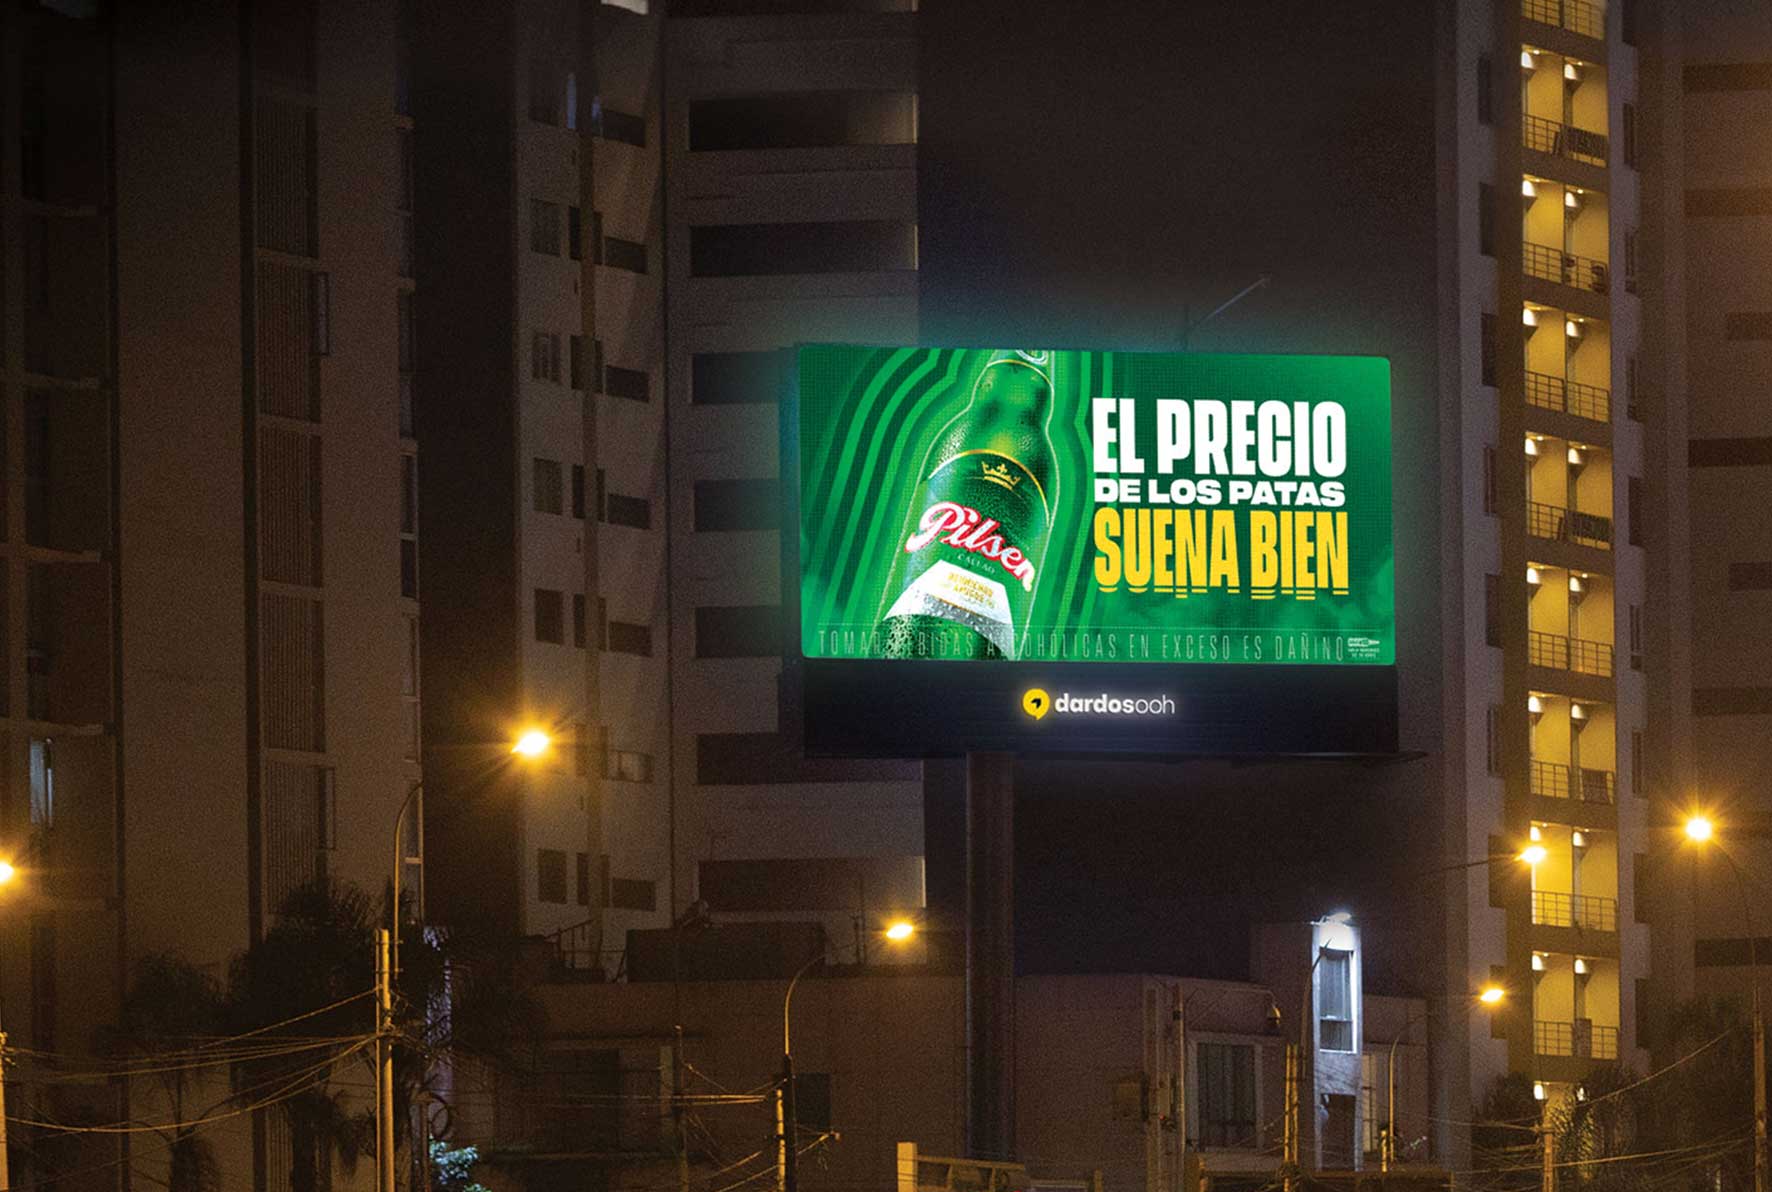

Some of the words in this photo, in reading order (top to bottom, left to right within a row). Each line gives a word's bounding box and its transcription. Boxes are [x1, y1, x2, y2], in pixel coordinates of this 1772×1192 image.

[1092, 398, 1145, 474] EL
[1157, 398, 1347, 478] PRECIO
[1094, 478, 1141, 503] DE
[1148, 479, 1222, 505] LOS
[1229, 481, 1346, 507] PATAS
[904, 501, 1035, 592] Pilsen
[1094, 507, 1241, 588] SUENA
[1250, 510, 1349, 590] BIEN
[818, 629, 880, 655] TOMAR
[986, 629, 1116, 659] ACOHÓLICAS
[1129, 634, 1149, 658] EN
[1162, 634, 1230, 660] EXCESO
[1243, 635, 1262, 660] ES
[1275, 632, 1344, 662] DAÑINO
